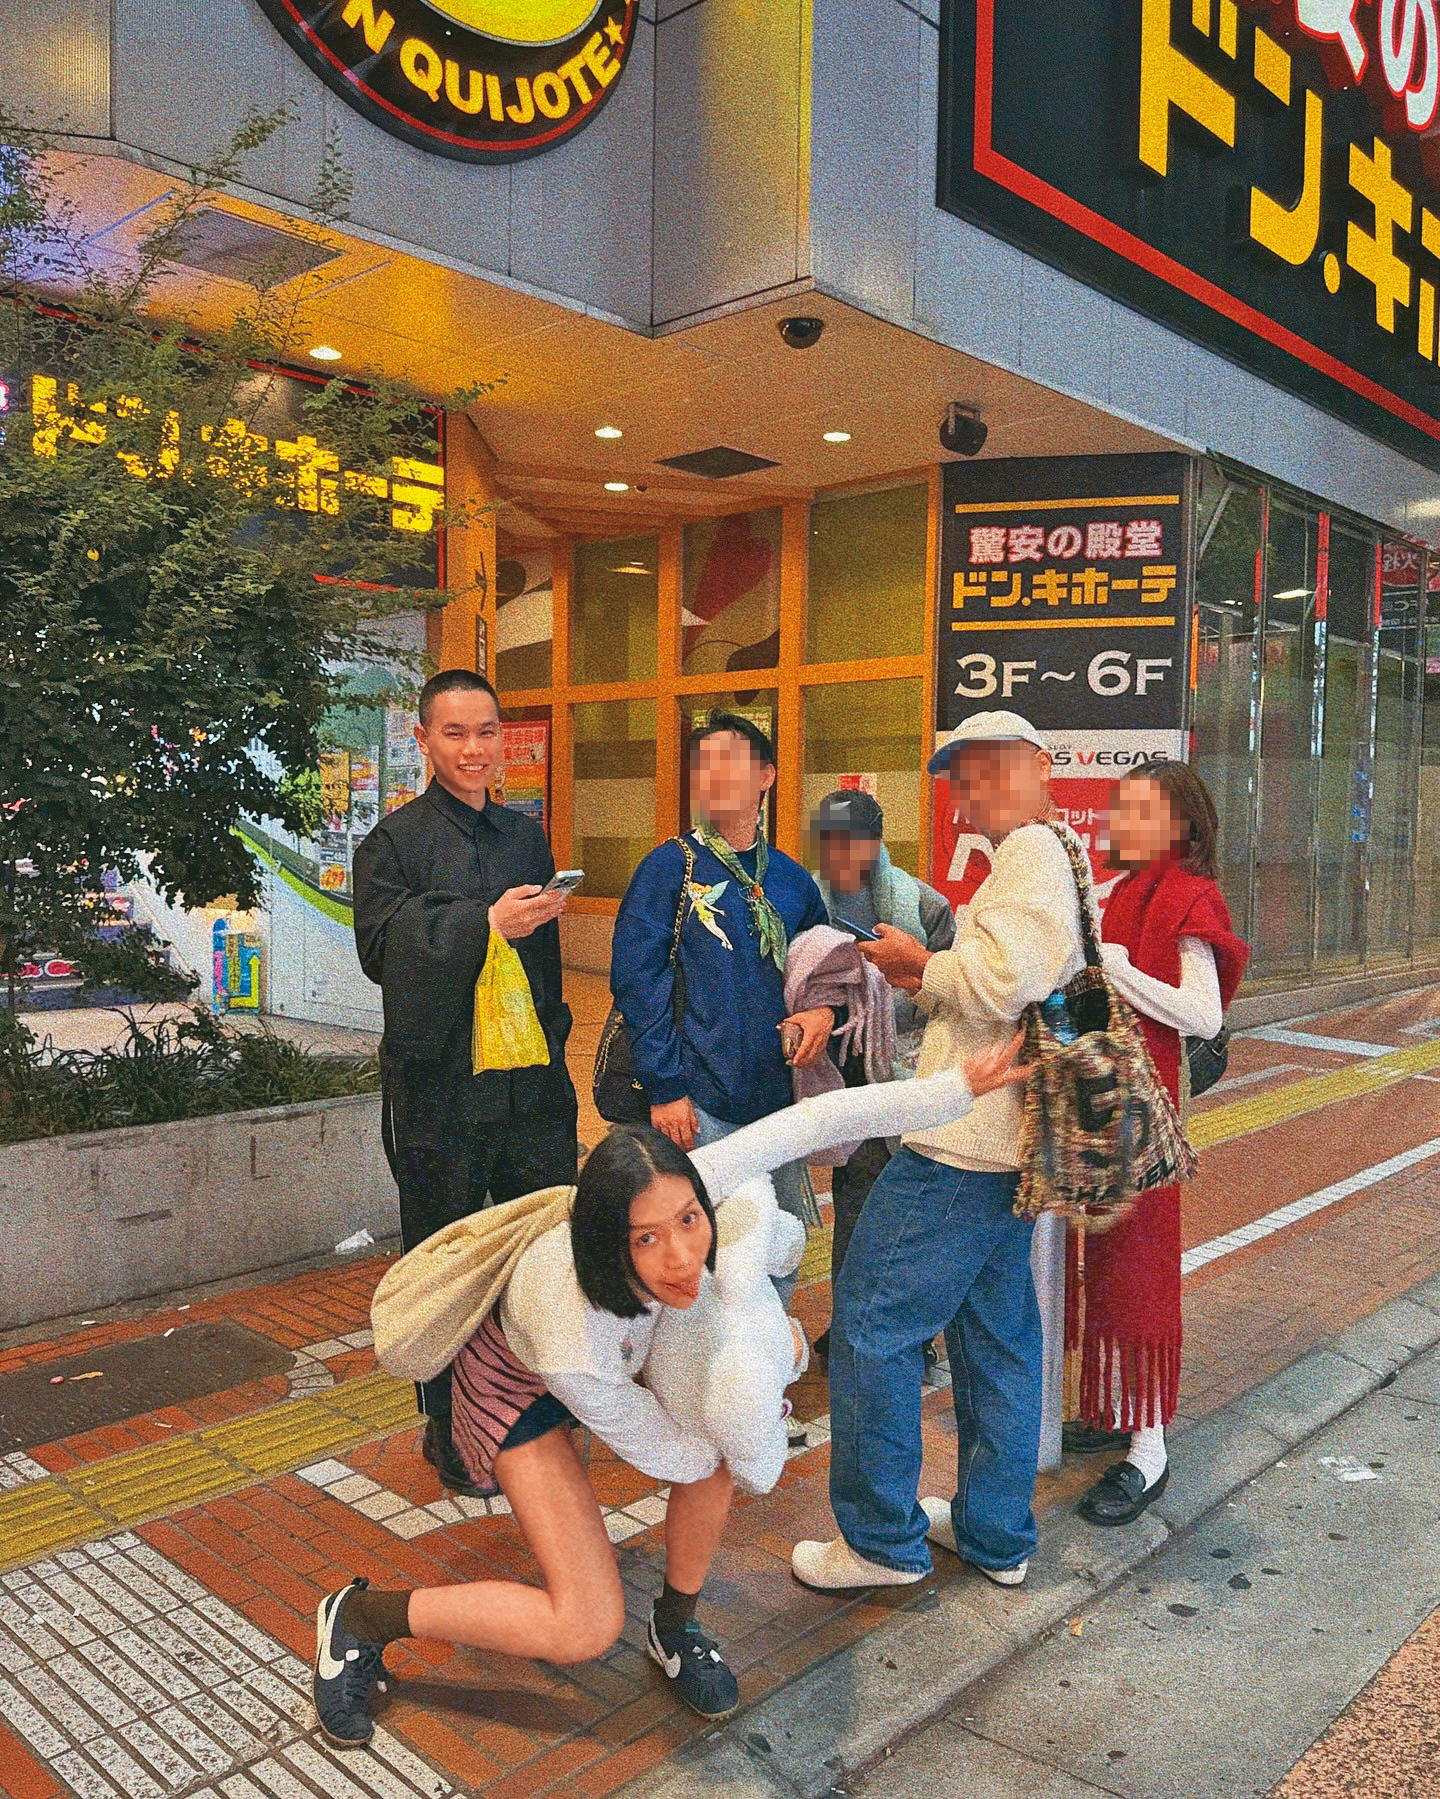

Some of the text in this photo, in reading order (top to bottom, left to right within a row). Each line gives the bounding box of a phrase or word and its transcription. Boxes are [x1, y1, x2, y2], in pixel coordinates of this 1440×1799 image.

[400, 31, 620, 124] QUIJOTE
[968, 520, 1163, 565] 驚安の殿堂
[1076, 751, 1168, 766] VEGAS
